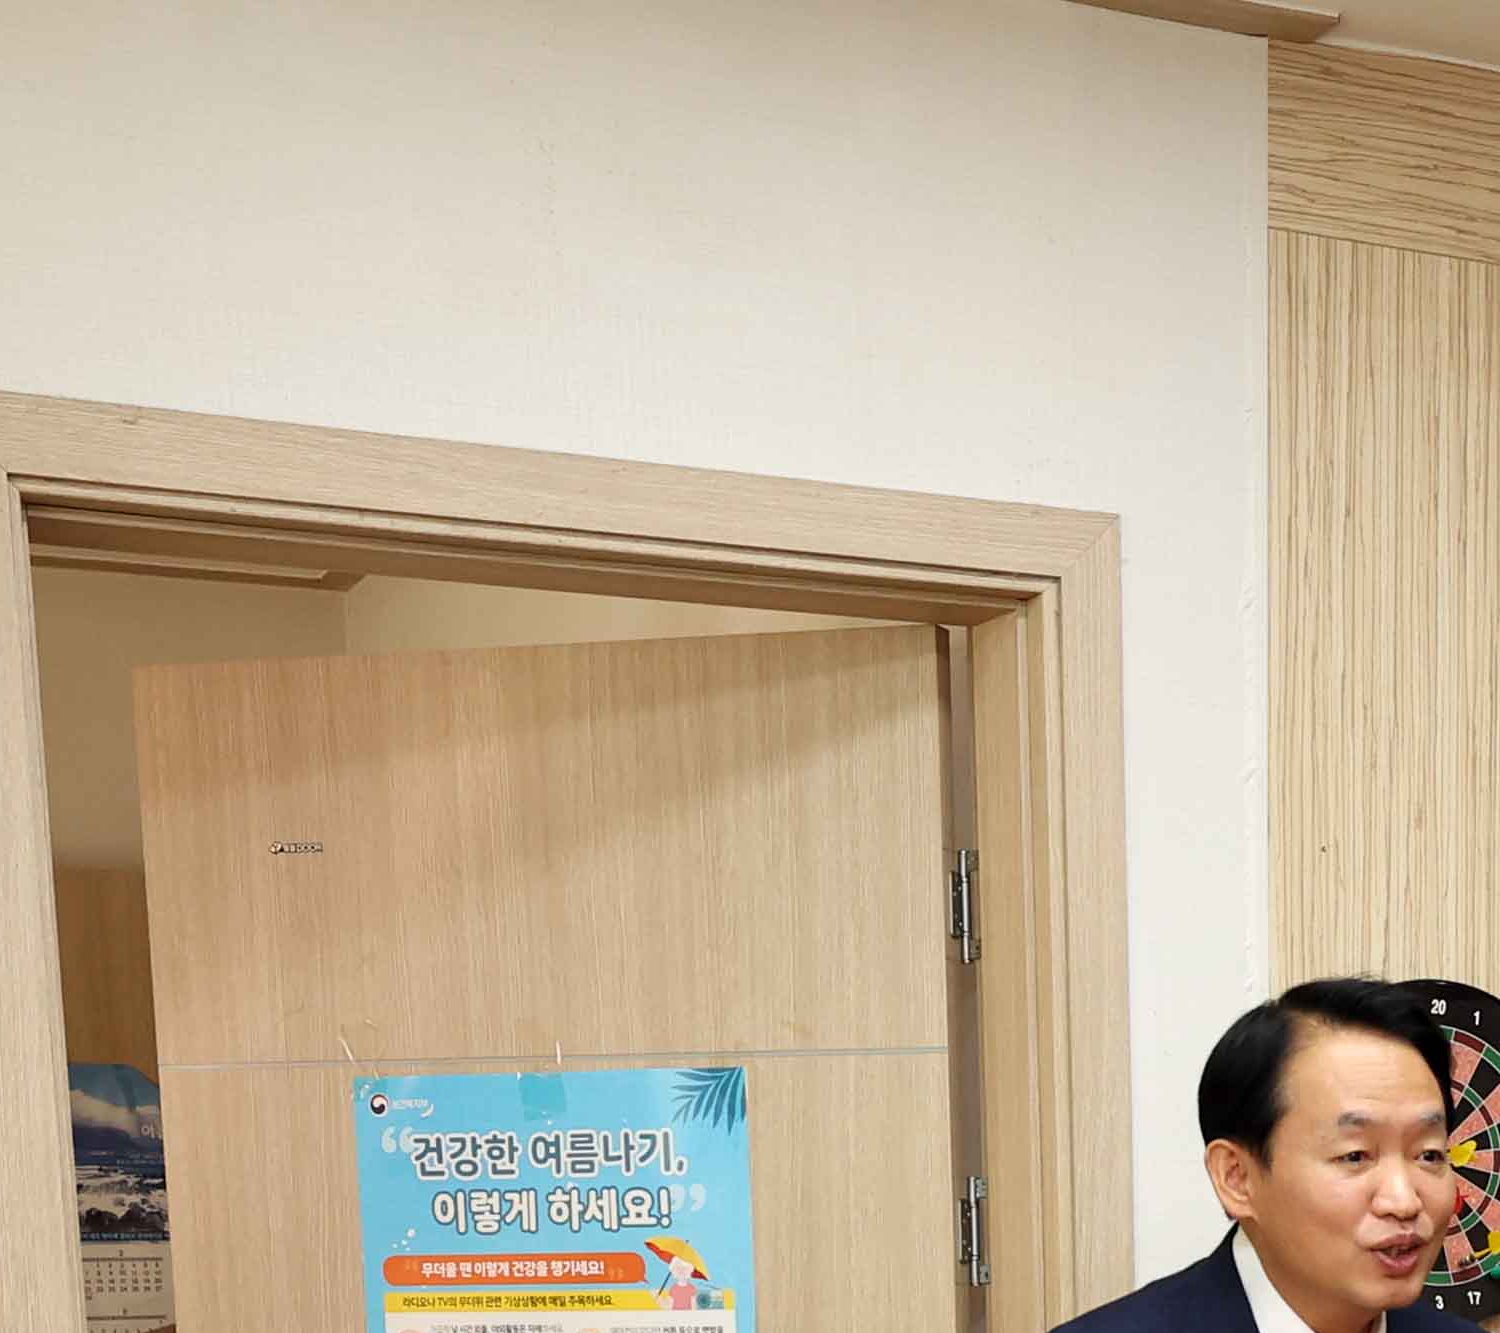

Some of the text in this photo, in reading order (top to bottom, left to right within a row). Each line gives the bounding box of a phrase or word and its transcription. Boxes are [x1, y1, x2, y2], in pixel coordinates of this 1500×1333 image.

[1431, 999, 1447, 1016] 20
[1473, 1011, 1480, 1025] 1
[412, 1129, 688, 1179] 건강한 여름나기,
[432, 1185, 672, 1235] 이렇게 하세요!
[421, 1262, 457, 1278] 무더울
[474, 1262, 509, 1278] 이렇게
[512, 1262, 548, 1278] 건강을
[550, 1261, 604, 1277] 챙기세요!
[403, 1296, 435, 1308] 라디오나
[437, 1296, 457, 1307] TV의
[459, 1296, 484, 1307] 무더위
[486, 1296, 502, 1307] 관련
[1435, 1295, 1444, 1309] 3
[1468, 1291, 1481, 1306] 17
